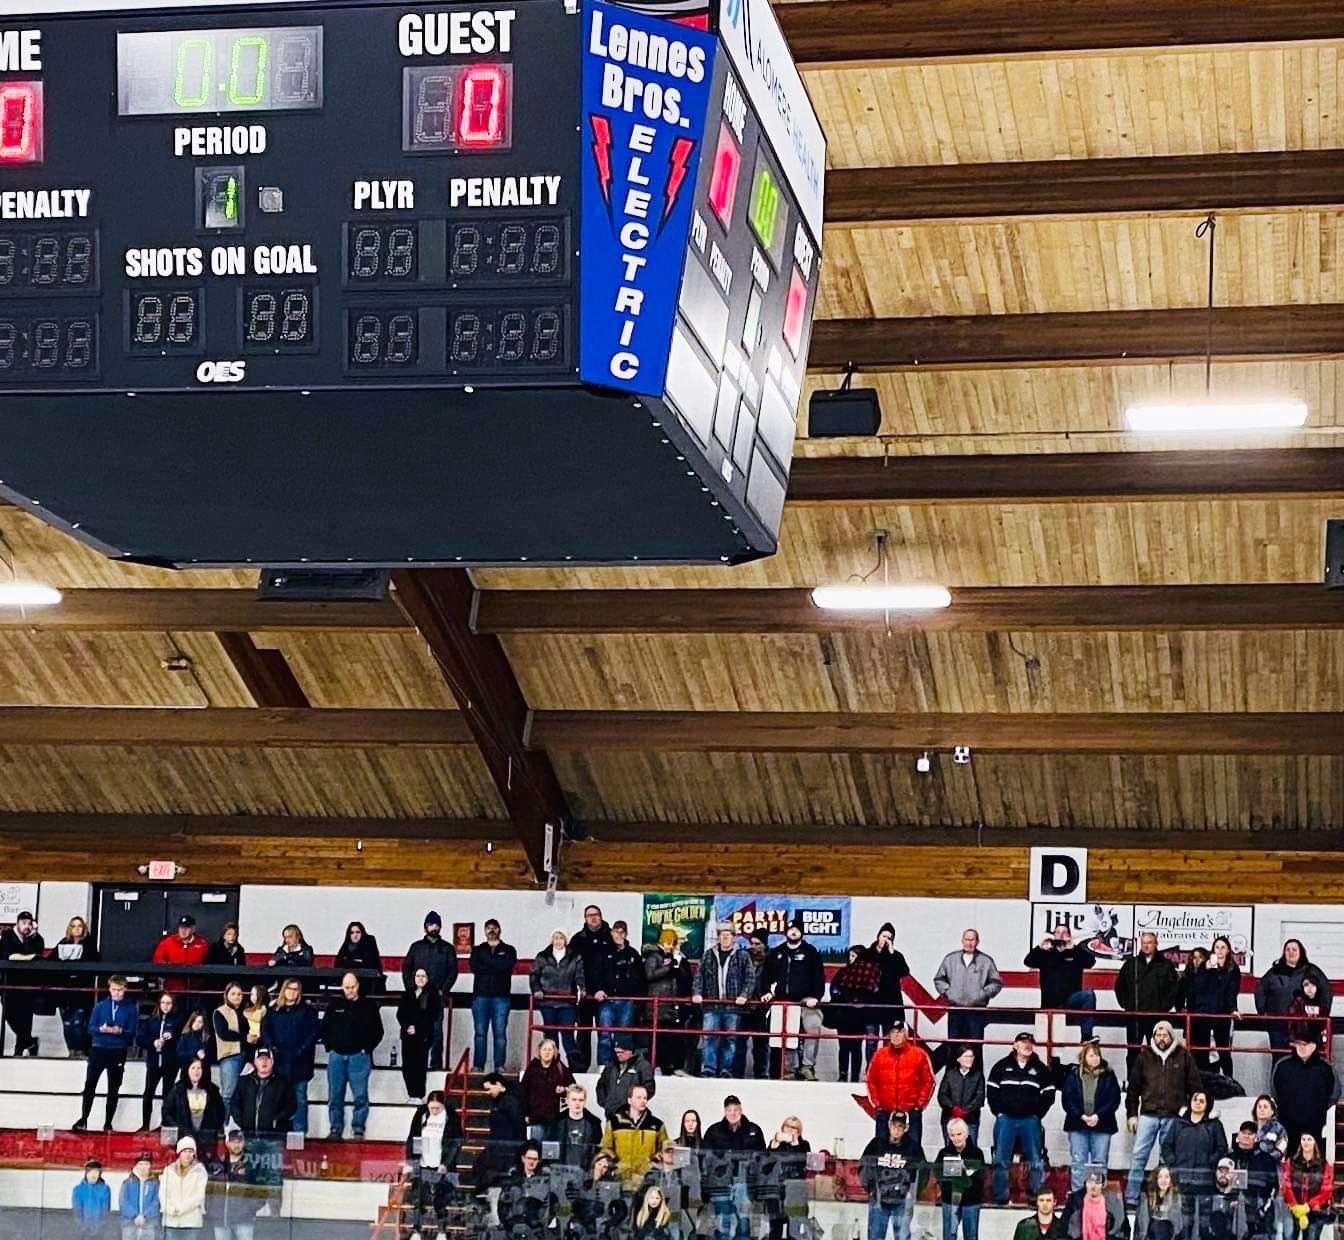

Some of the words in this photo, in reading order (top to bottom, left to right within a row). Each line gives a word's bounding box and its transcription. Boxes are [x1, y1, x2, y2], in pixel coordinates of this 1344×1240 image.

[399, 9, 515, 55] GUEST
[589, 12, 706, 83] Lennes
[455, 64, 505, 145] 0
[602, 64, 690, 128] Bros.
[723, 71, 748, 145] HOME
[174, 126, 267, 156] PERIOD
[354, 180, 415, 209] PLYR
[450, 176, 562, 207] PENALTY
[125, 248, 203, 277] SHOTS
[211, 246, 246, 275] ON
[253, 245, 317, 274] GOAL
[610, 124, 657, 380] ELECTRIC
[196, 361, 246, 382] OES
[1040, 855, 1080, 896] D
[733, 910, 786, 922] PARTY
[802, 911, 834, 922] BUD
[803, 922, 840, 935] IGHT
[1137, 909, 1214, 931] Angelina's
